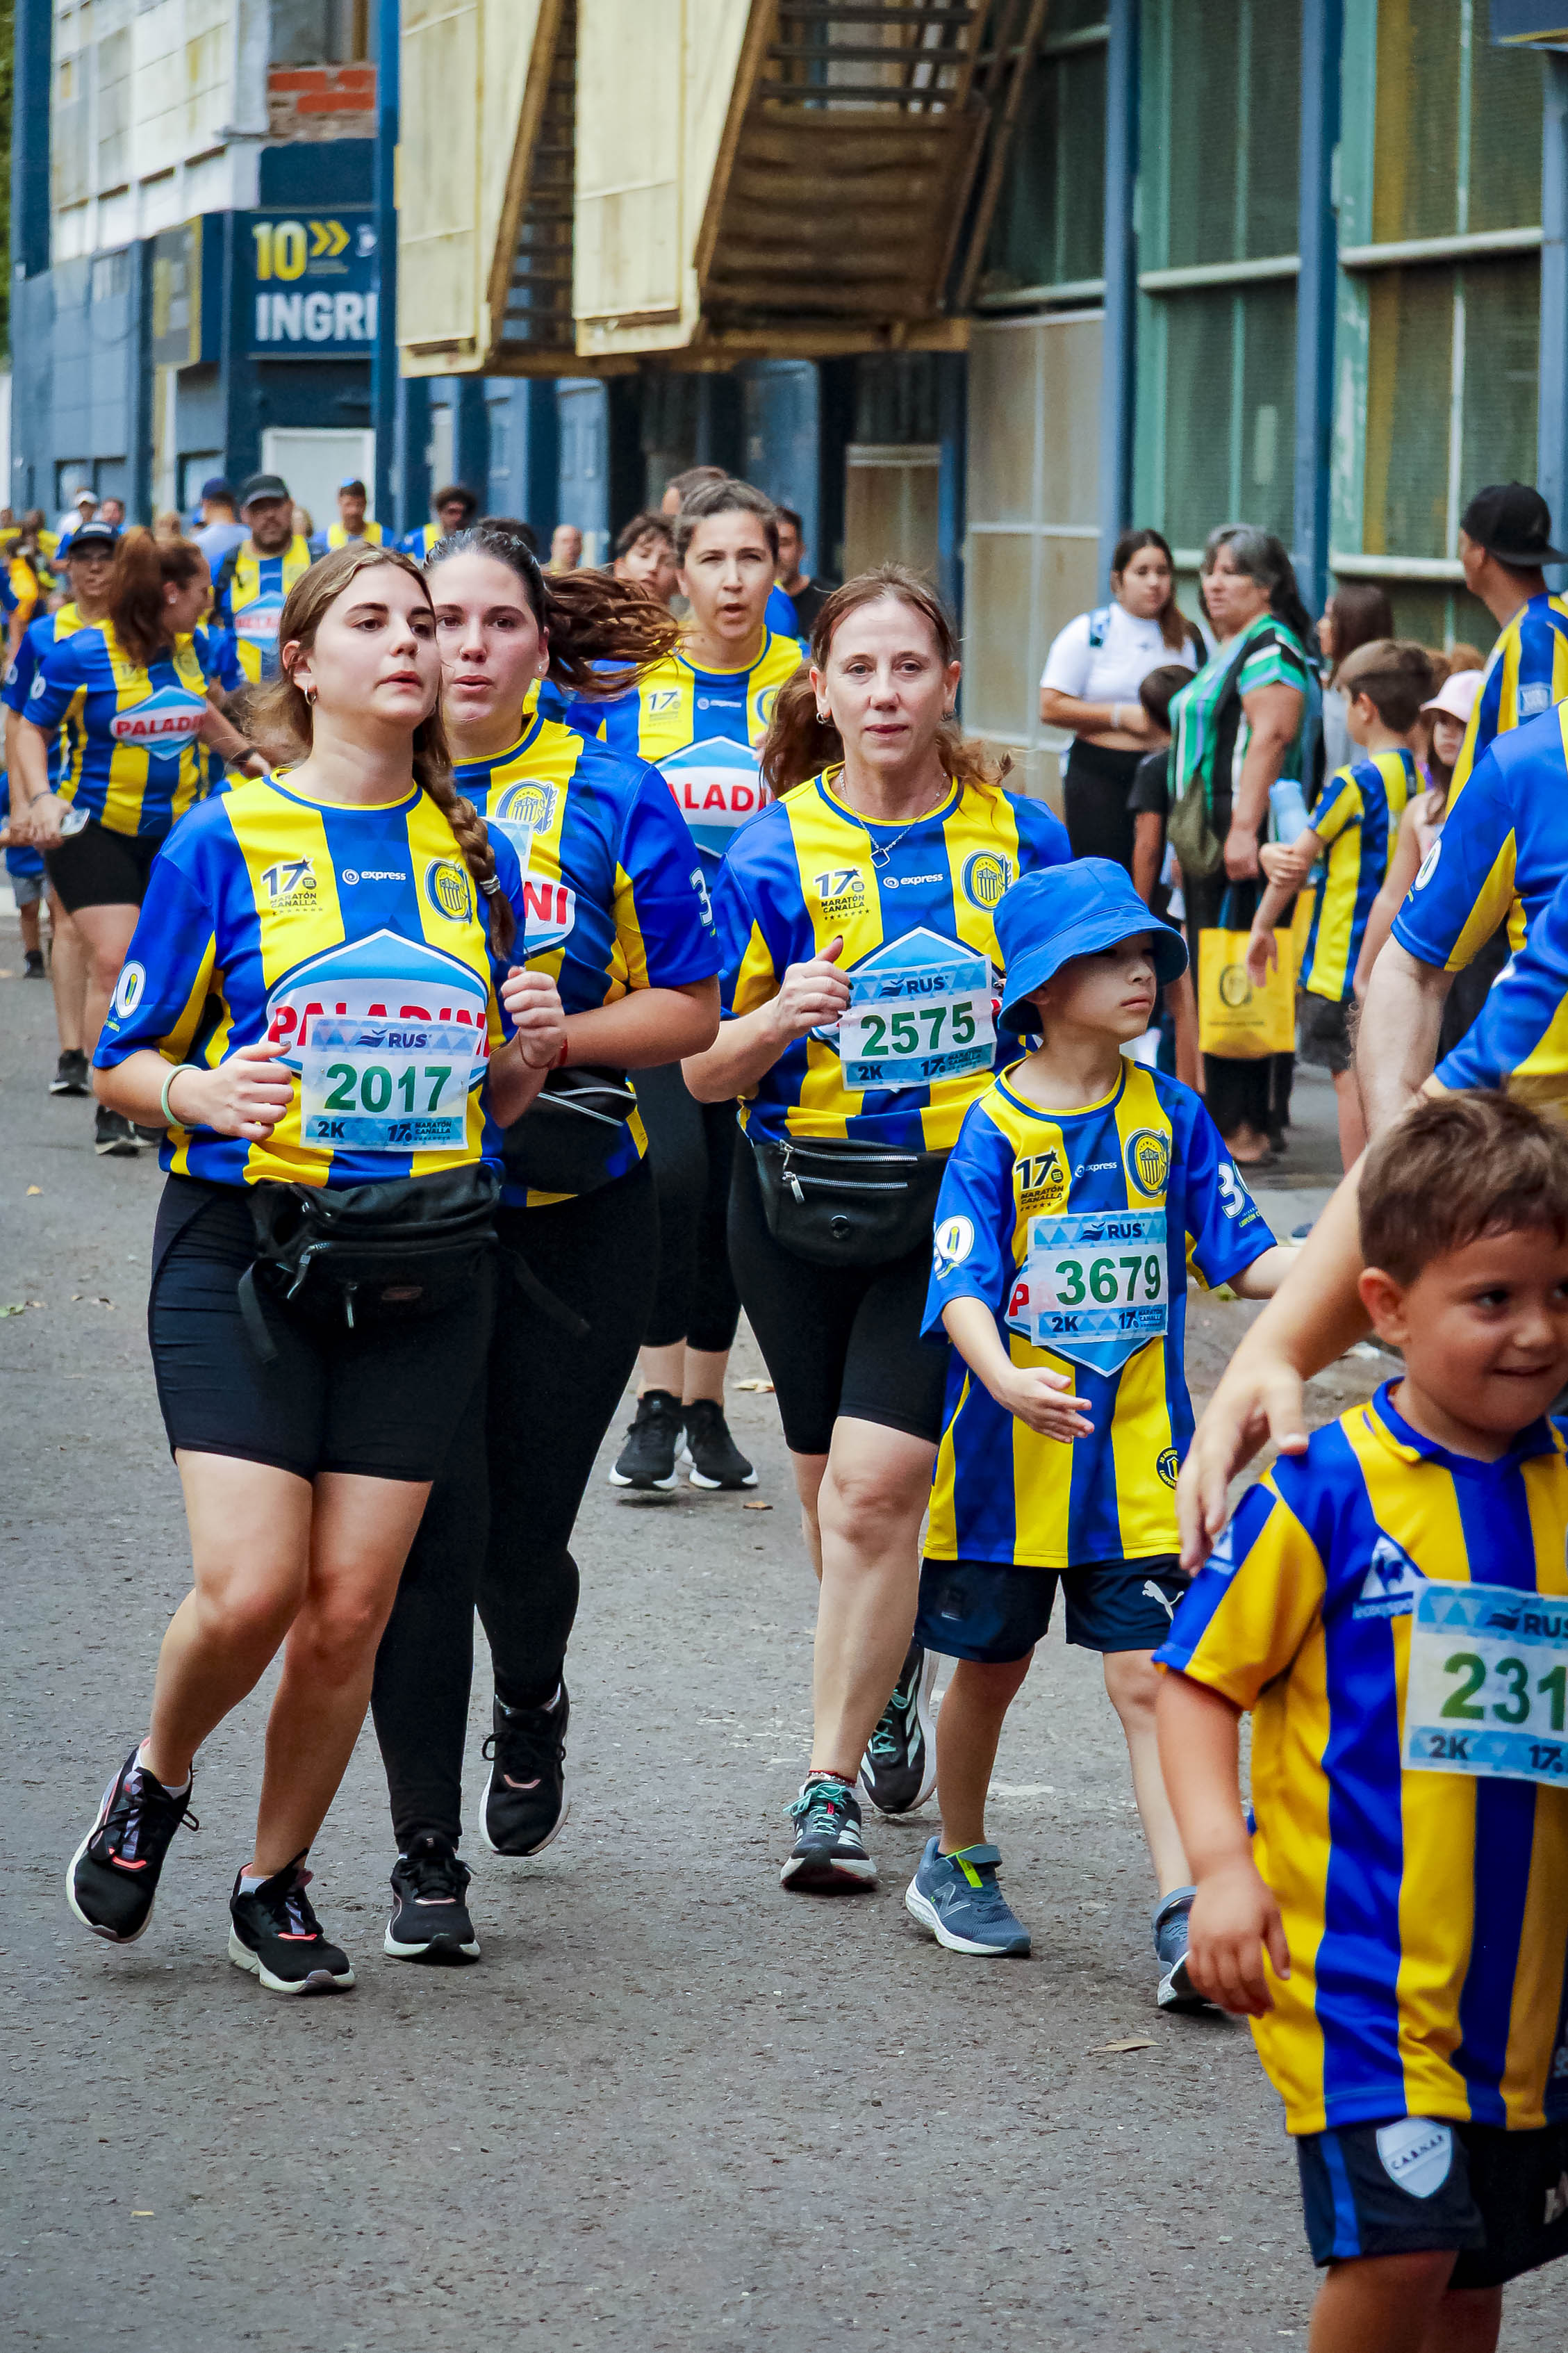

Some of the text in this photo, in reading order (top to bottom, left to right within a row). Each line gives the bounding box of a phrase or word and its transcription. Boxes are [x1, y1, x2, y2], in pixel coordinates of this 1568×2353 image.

[252, 220, 307, 280] 10
[256, 292, 379, 341] INGRI
[263, 860, 311, 898] 17
[361, 870, 406, 880] express
[814, 868, 861, 899] 17
[900, 874, 943, 885] express
[270, 892, 317, 903] MARATÓN
[271, 899, 317, 908] CANALLA
[821, 894, 864, 908] MARATÓN
[823, 901, 865, 913] CANALLA
[907, 976, 946, 994] RUS
[861, 1001, 976, 1057] 2575
[388, 1033, 428, 1049] RUS
[859, 1065, 884, 1081] 2K
[921, 1057, 945, 1076] 17
[324, 1063, 452, 1113] 2017
[317, 1120, 345, 1138] 2K
[387, 1122, 412, 1142] 17
[1016, 1151, 1057, 1190] 17
[1021, 1185, 1064, 1199] MARATÓN
[1021, 1192, 1062, 1205] CANALLA
[1218, 1161, 1248, 1219] 3
[1108, 1222, 1141, 1238] RUS
[1055, 1254, 1161, 1306] 3679
[1052, 1315, 1078, 1332] 2K
[1119, 1311, 1136, 1329] 17
[1524, 1613, 1568, 1639] RU
[1439, 1652, 1567, 1732] 231
[1429, 1734, 1469, 1760] 2K
[1529, 1744, 1562, 1771] 17
